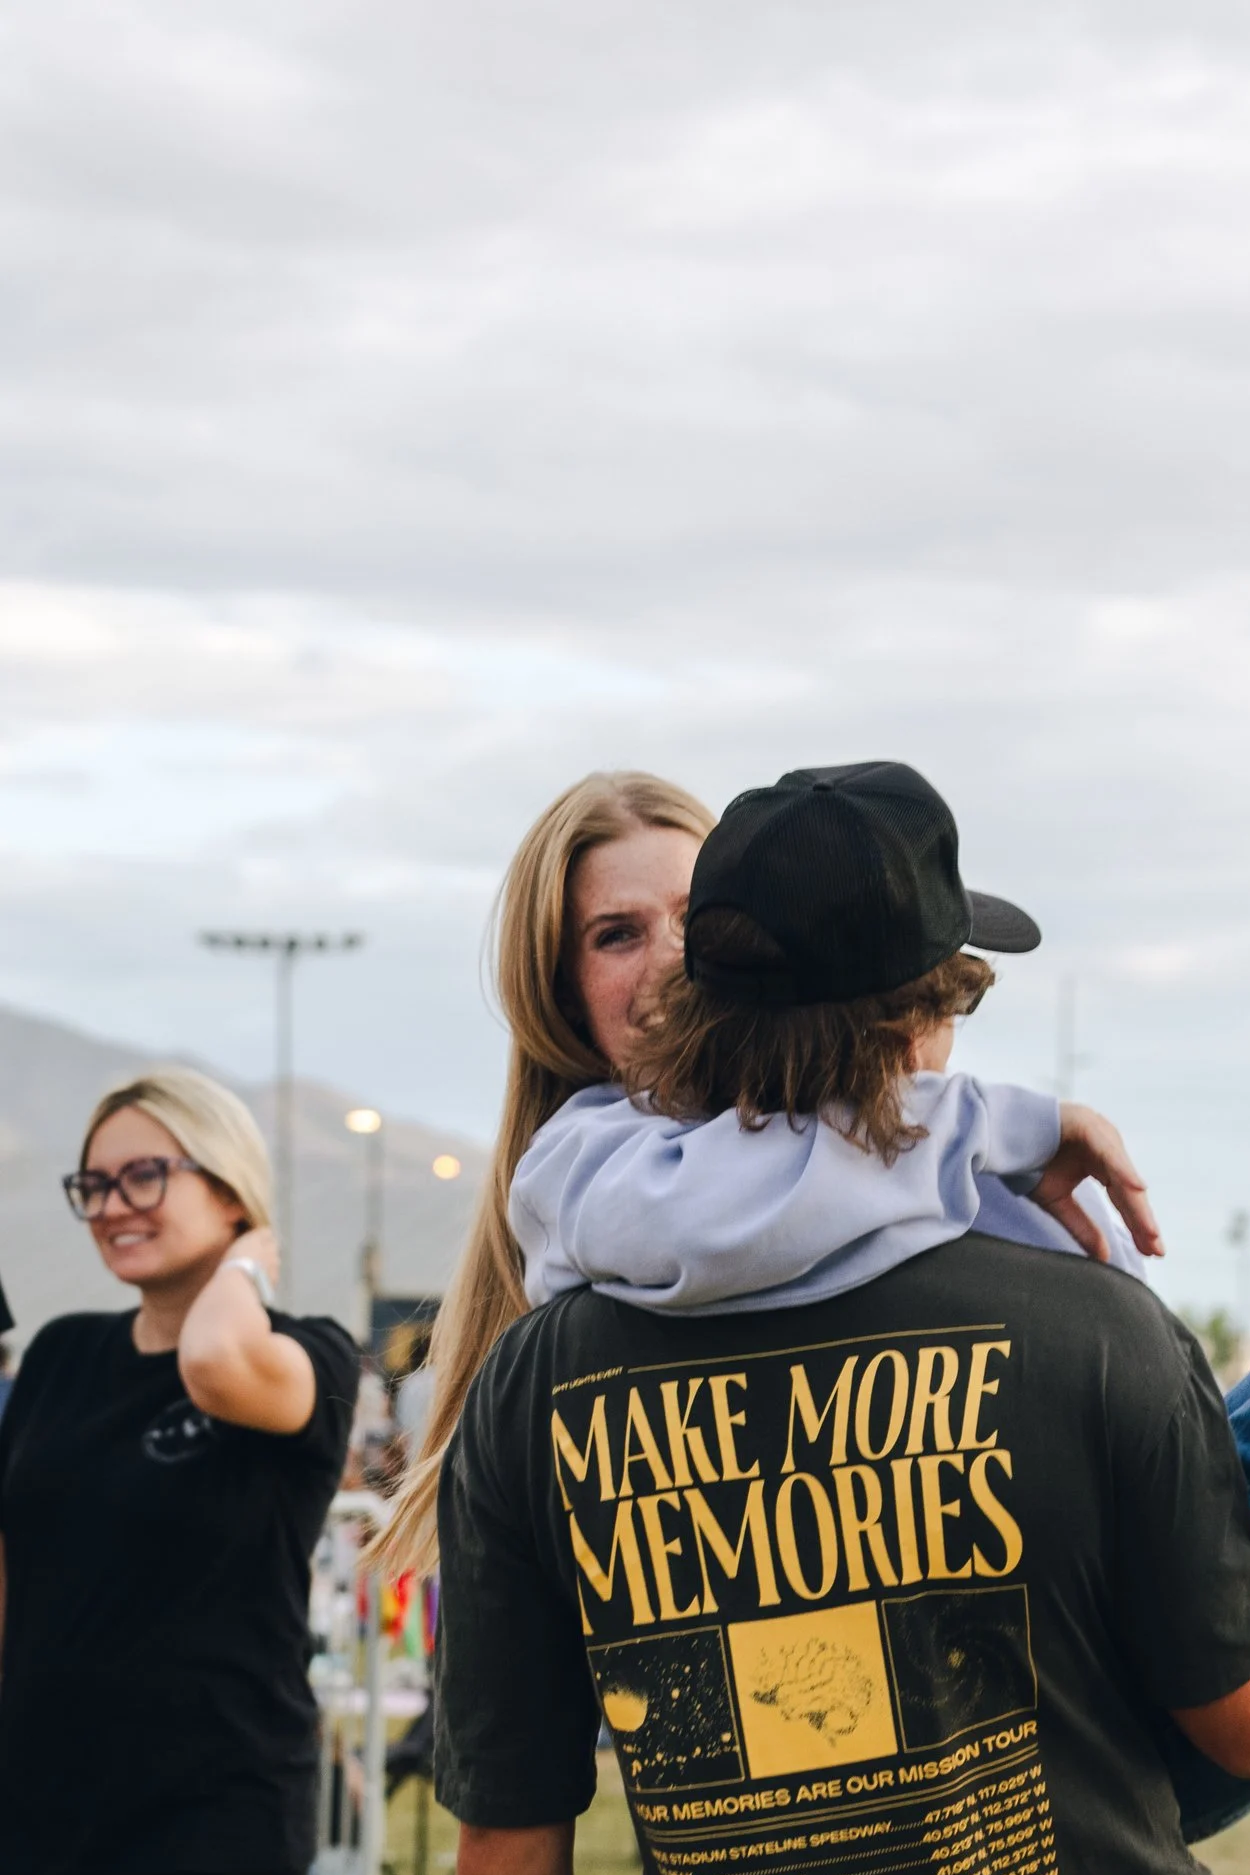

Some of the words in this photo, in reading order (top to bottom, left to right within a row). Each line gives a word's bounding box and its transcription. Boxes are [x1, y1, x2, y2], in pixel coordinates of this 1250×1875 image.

[551, 1372, 761, 1512] MAKE
[780, 1340, 1011, 1474] MORE
[567, 1448, 1024, 1636] MEMORIES
[671, 1788, 791, 1822] MEMORIES
[796, 1778, 843, 1804] ARE
[846, 1769, 895, 1794] OUR
[898, 1741, 980, 1784] MISSION
[982, 1719, 1038, 1753] TOUR
[1033, 1780, 1047, 1798] W
[669, 1848, 727, 1866] STADIUM
[729, 1836, 807, 1860] STATELINE
[809, 1820, 892, 1847] SPEEDWAY
[1029, 1762, 1043, 1780] W
[1036, 1798, 1050, 1815] W
[1039, 1815, 1053, 1832] W
[1041, 1832, 1055, 1849] W
[1042, 1850, 1057, 1866] W
